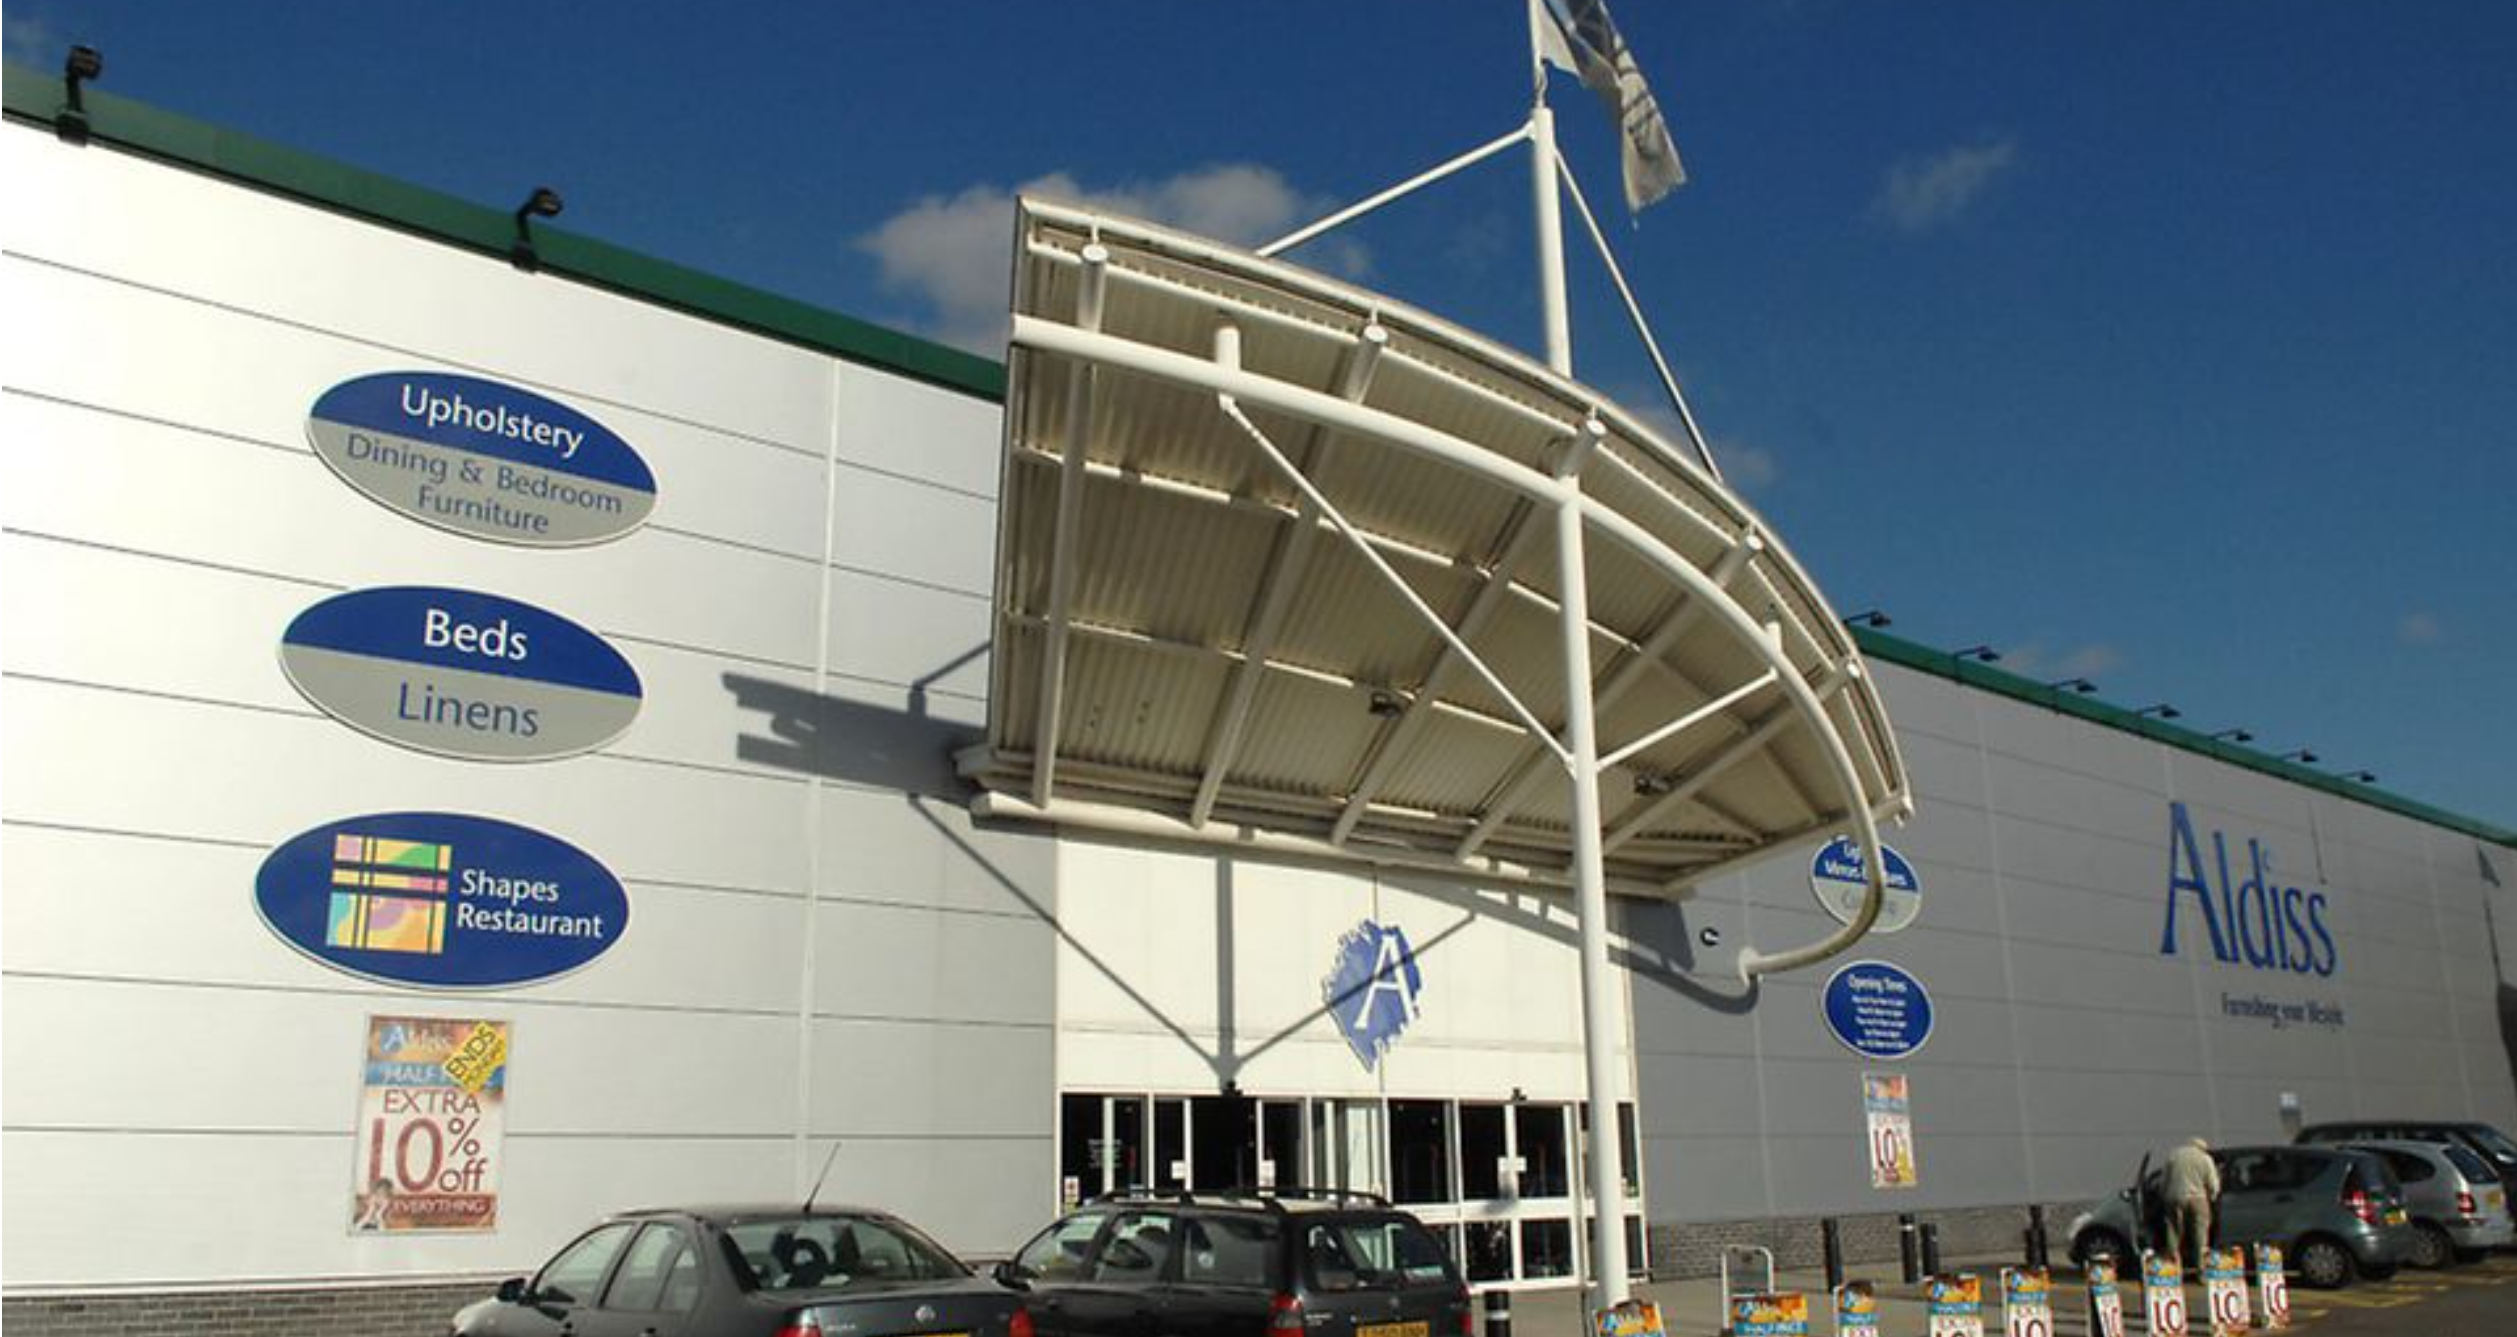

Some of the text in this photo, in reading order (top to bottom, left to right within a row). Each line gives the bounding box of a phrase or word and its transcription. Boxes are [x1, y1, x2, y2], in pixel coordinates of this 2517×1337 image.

[401, 383, 585, 459] Upholstery
[347, 432, 623, 514] Dining & Bedroom
[418, 485, 550, 534] Furniture
[424, 608, 528, 661] Beds
[398, 681, 540, 738] Linens
[460, 868, 559, 906] Shapes
[2160, 801, 2336, 978] Aldiss
[456, 902, 603, 939] Restaurant
[1353, 934, 1416, 1030] A
[382, 1063, 437, 1083] HALF
[445, 1023, 497, 1080] ENDS
[384, 1088, 482, 1114] EXTRA
[437, 1157, 489, 1192] off
[391, 1197, 486, 1214] EVERYTHING
